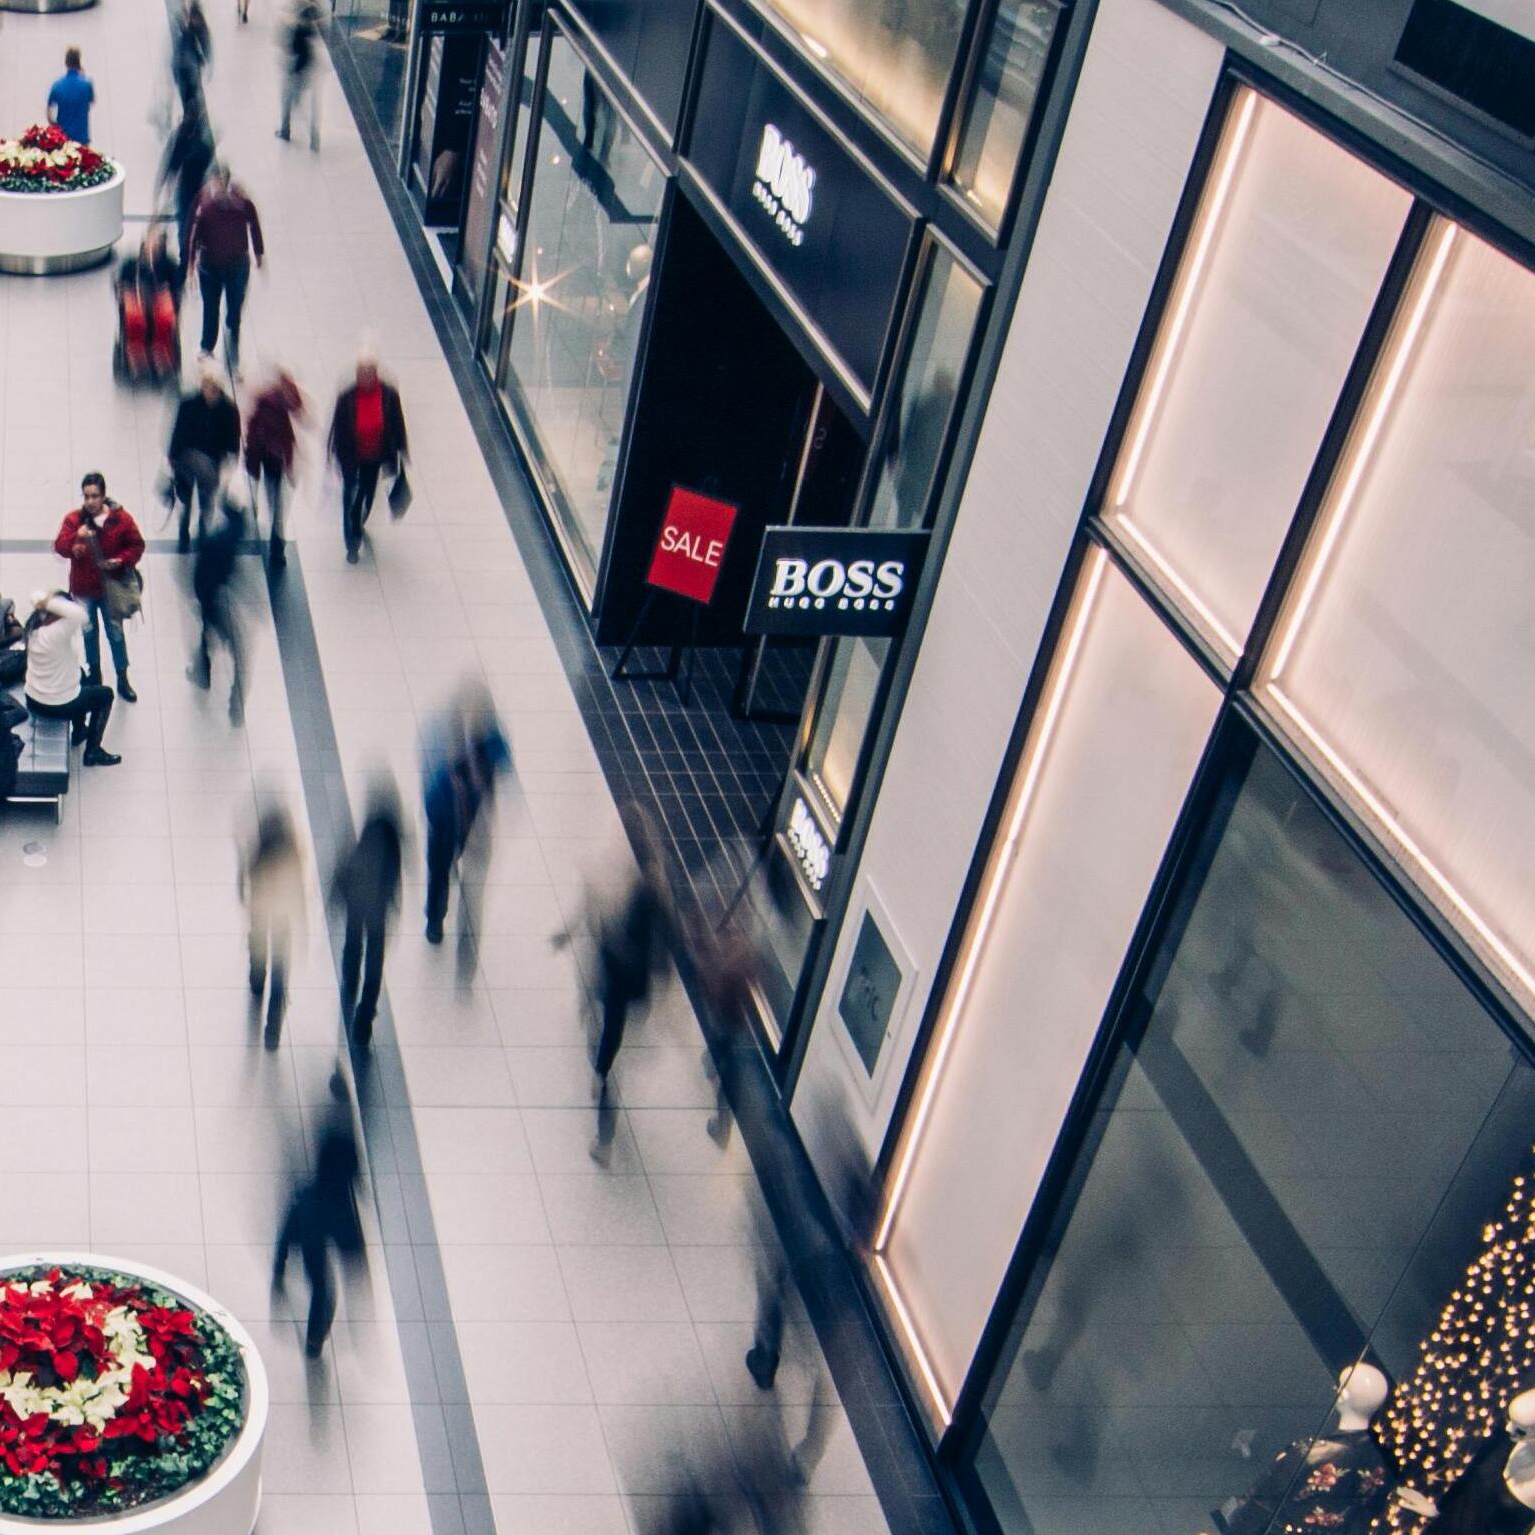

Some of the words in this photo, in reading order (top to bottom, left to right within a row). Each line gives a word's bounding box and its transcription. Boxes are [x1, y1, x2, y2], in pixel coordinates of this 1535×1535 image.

[660, 525, 724, 567] SALE
[769, 557, 905, 599] BOSS
[767, 595, 826, 610] HUGO
[837, 596, 896, 611] BOSS
